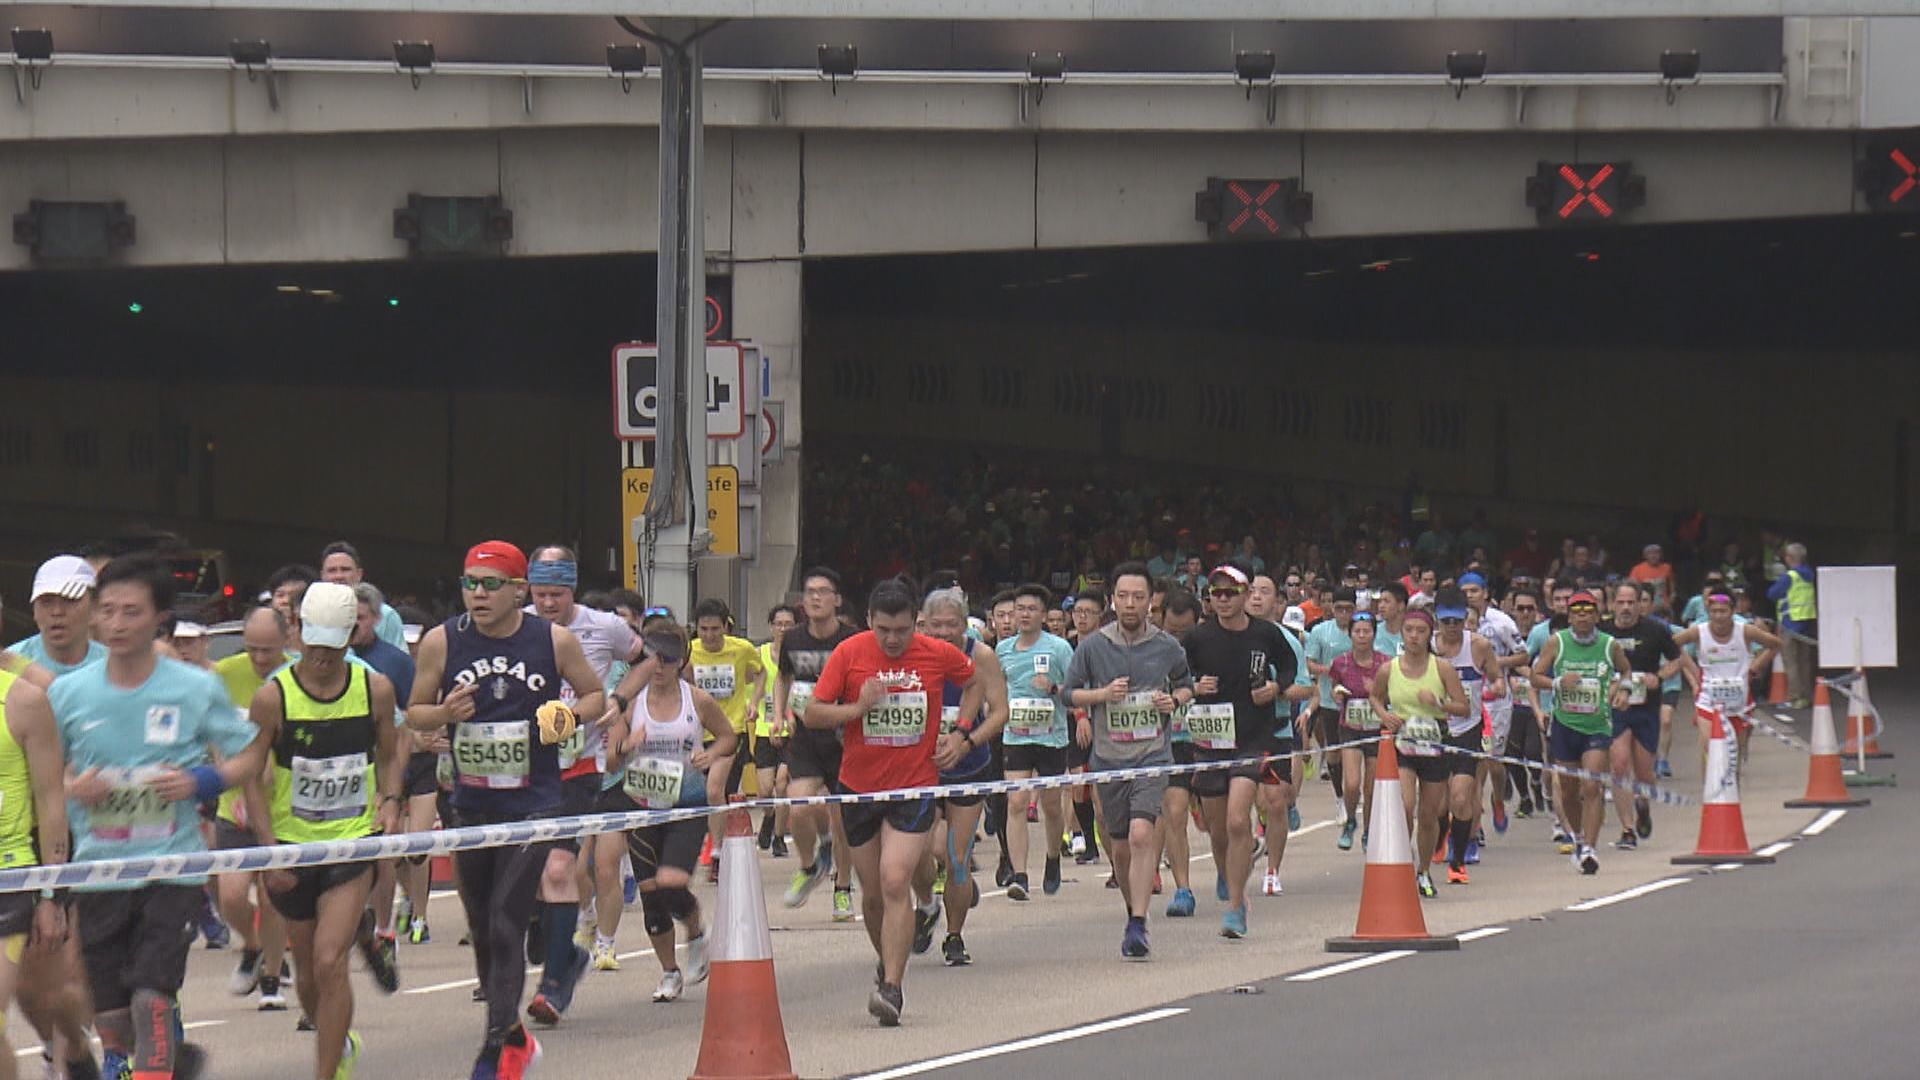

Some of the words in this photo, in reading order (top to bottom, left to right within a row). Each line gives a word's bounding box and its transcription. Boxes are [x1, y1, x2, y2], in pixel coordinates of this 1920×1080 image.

[454, 656, 546, 691] DBSAC
[867, 707, 924, 726] E4993
[1011, 708, 1052, 721] E7057
[1110, 709, 1158, 728] E0735
[1188, 717, 1231, 733] E3887
[458, 742, 527, 764] E5436
[298, 775, 362, 799] 27078
[627, 769, 678, 795] E3037
